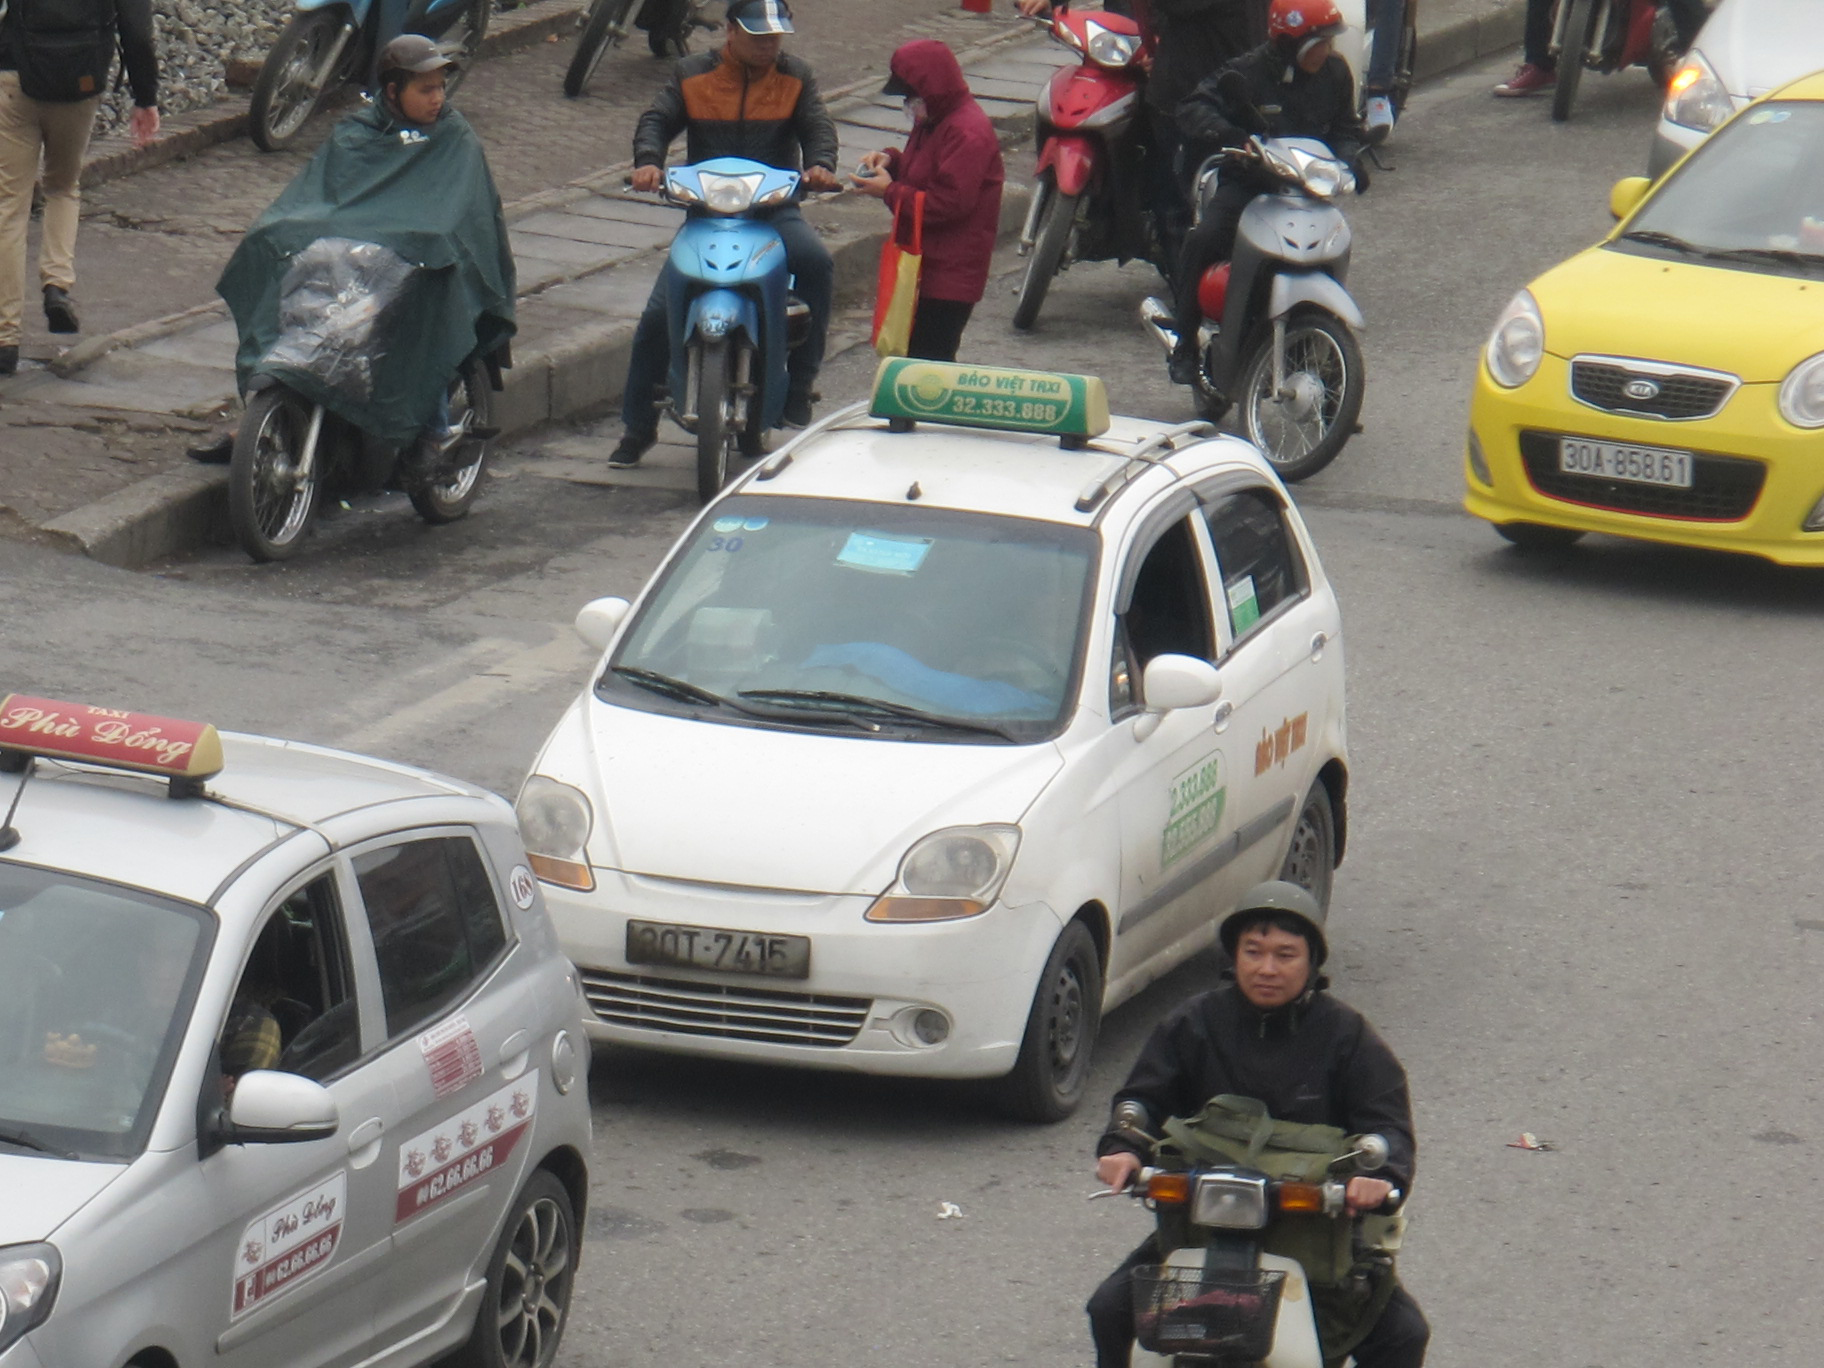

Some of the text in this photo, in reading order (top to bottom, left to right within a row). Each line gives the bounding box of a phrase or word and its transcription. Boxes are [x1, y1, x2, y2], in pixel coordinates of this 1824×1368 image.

[1029, 379, 1062, 394] TAXI
[1564, 443, 1687, 485] 30A-858.61
[0, 706, 82, 738] Phù
[87, 705, 132, 720] TAXI
